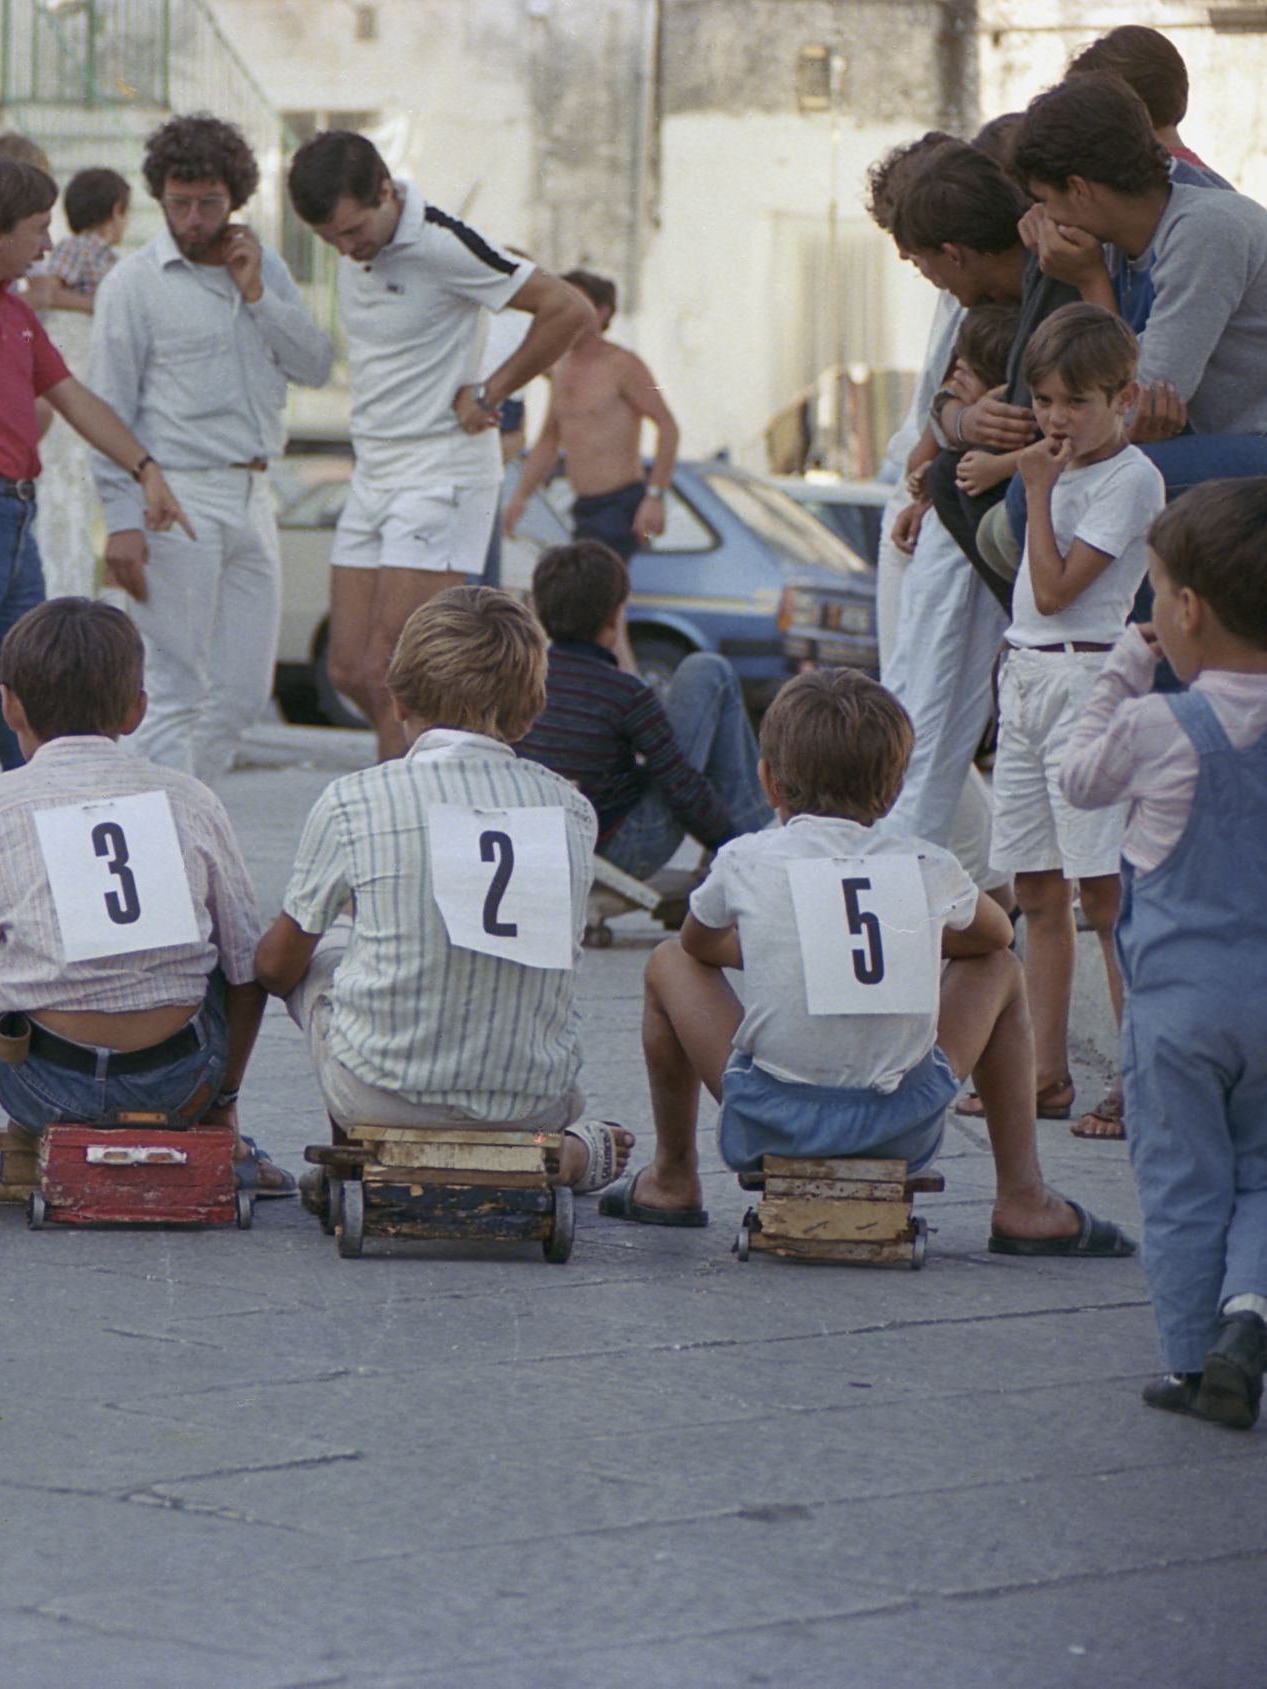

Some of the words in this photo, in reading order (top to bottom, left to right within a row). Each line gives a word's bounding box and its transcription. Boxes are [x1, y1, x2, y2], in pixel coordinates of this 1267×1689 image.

[91, 822, 141, 925] 3
[479, 830, 518, 938] 2
[841, 877, 885, 985] 5
